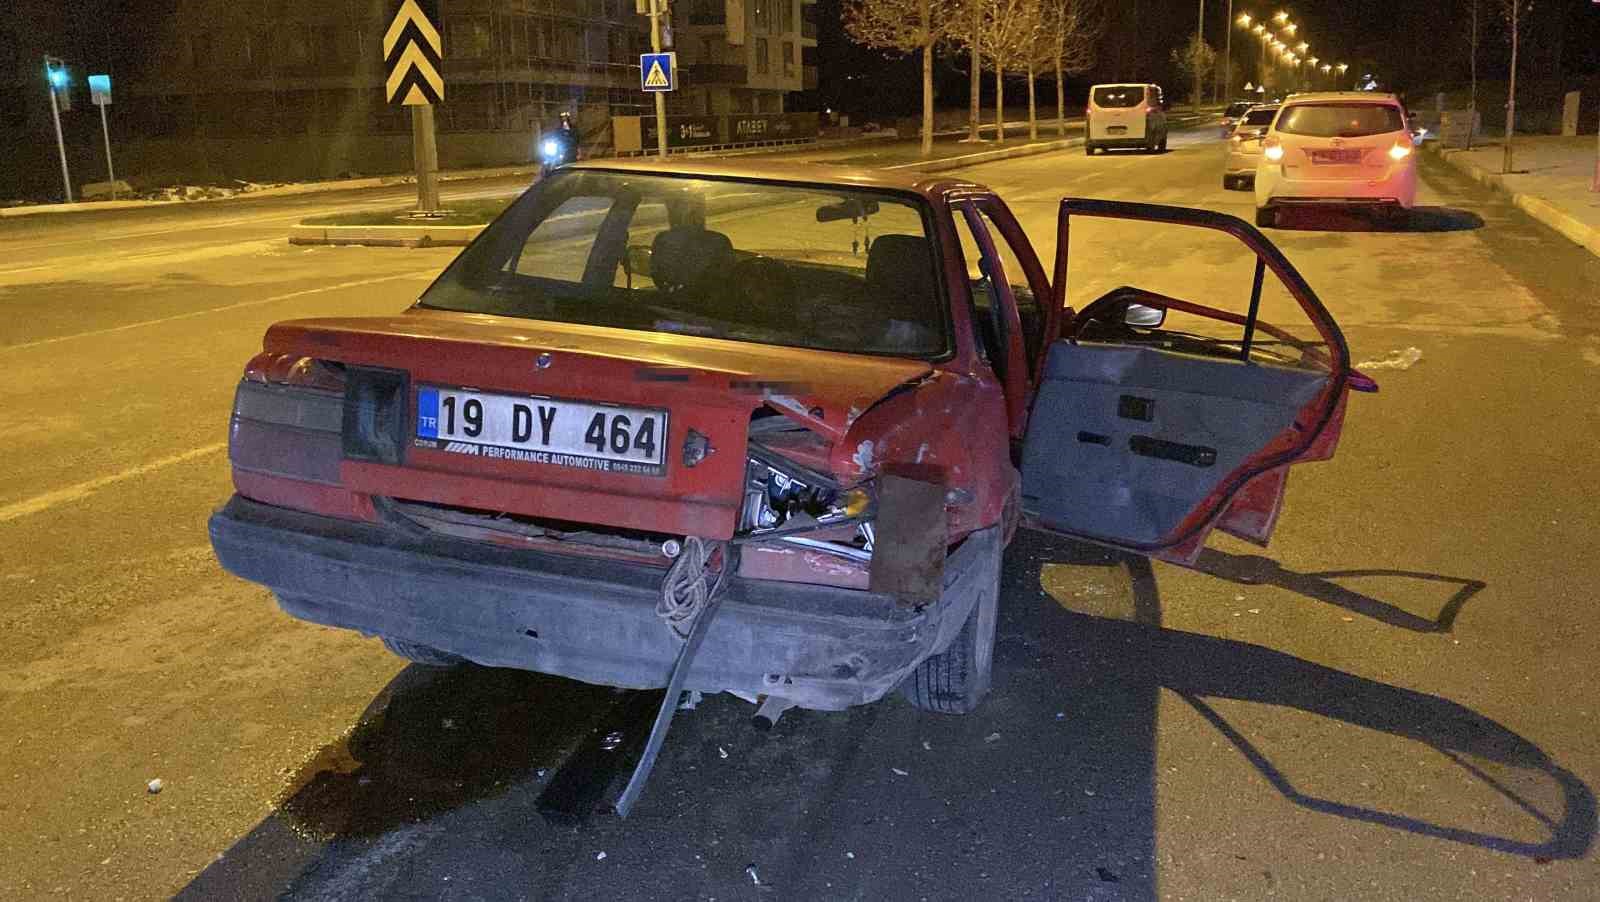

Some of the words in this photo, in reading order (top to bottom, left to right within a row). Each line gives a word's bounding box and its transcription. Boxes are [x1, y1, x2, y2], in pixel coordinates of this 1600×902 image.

[421, 416, 437, 429] TR
[442, 396, 483, 437] 19
[512, 403, 557, 446] DY
[584, 411, 655, 458] 464
[482, 446, 549, 464] PERFORMANCE
[551, 454, 610, 471] AUTOMOTIVE
